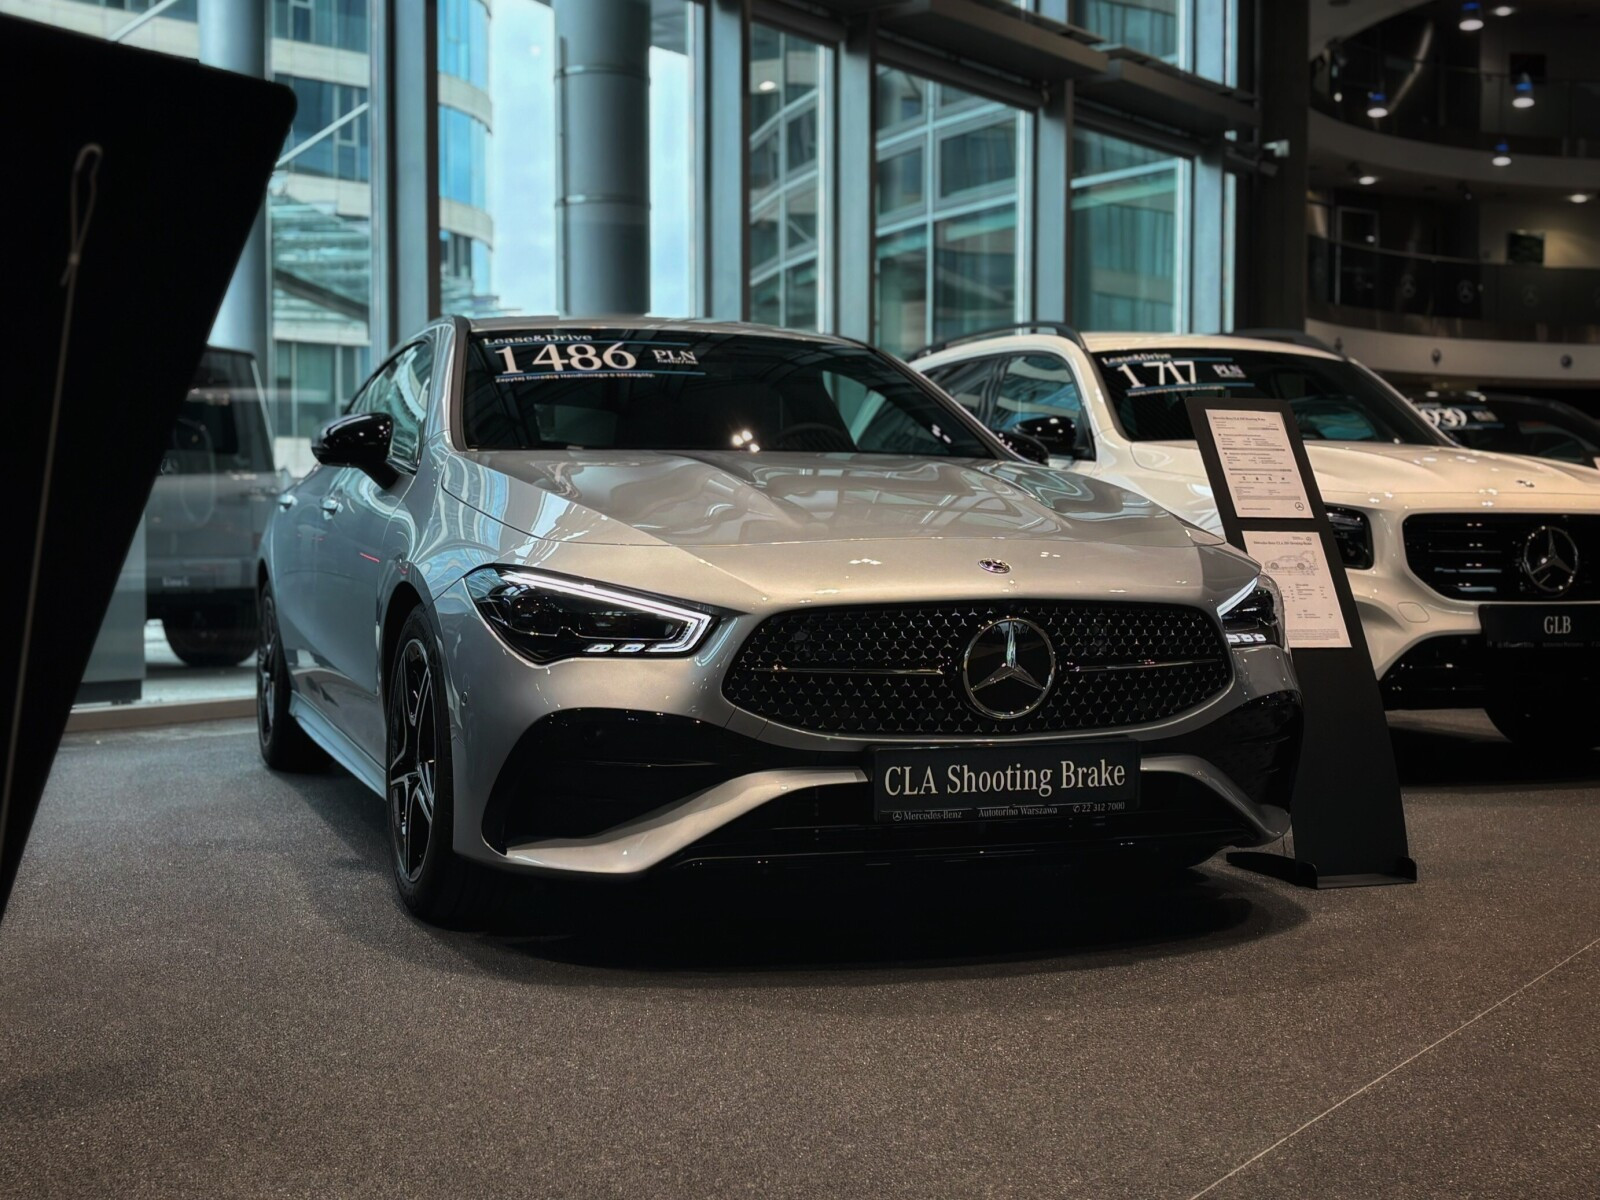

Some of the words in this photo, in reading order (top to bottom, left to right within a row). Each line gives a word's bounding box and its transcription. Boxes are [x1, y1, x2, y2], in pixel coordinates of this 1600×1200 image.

[483, 333, 592, 346] Lease&Drive
[495, 345, 524, 374] 1
[532, 341, 637, 371] 486
[651, 349, 696, 361] PLN
[1543, 615, 1571, 634] GLB
[884, 765, 939, 796] CLA
[947, 763, 1053, 797] Shooting
[1060, 758, 1126, 790] Brake
[903, 810, 963, 821] Mercedes-Benz
[1020, 805, 1058, 815] Warszawa
[1081, 804, 1091, 813] 22
[1092, 802, 1105, 812] 312
[1107, 801, 1125, 811] 7000
